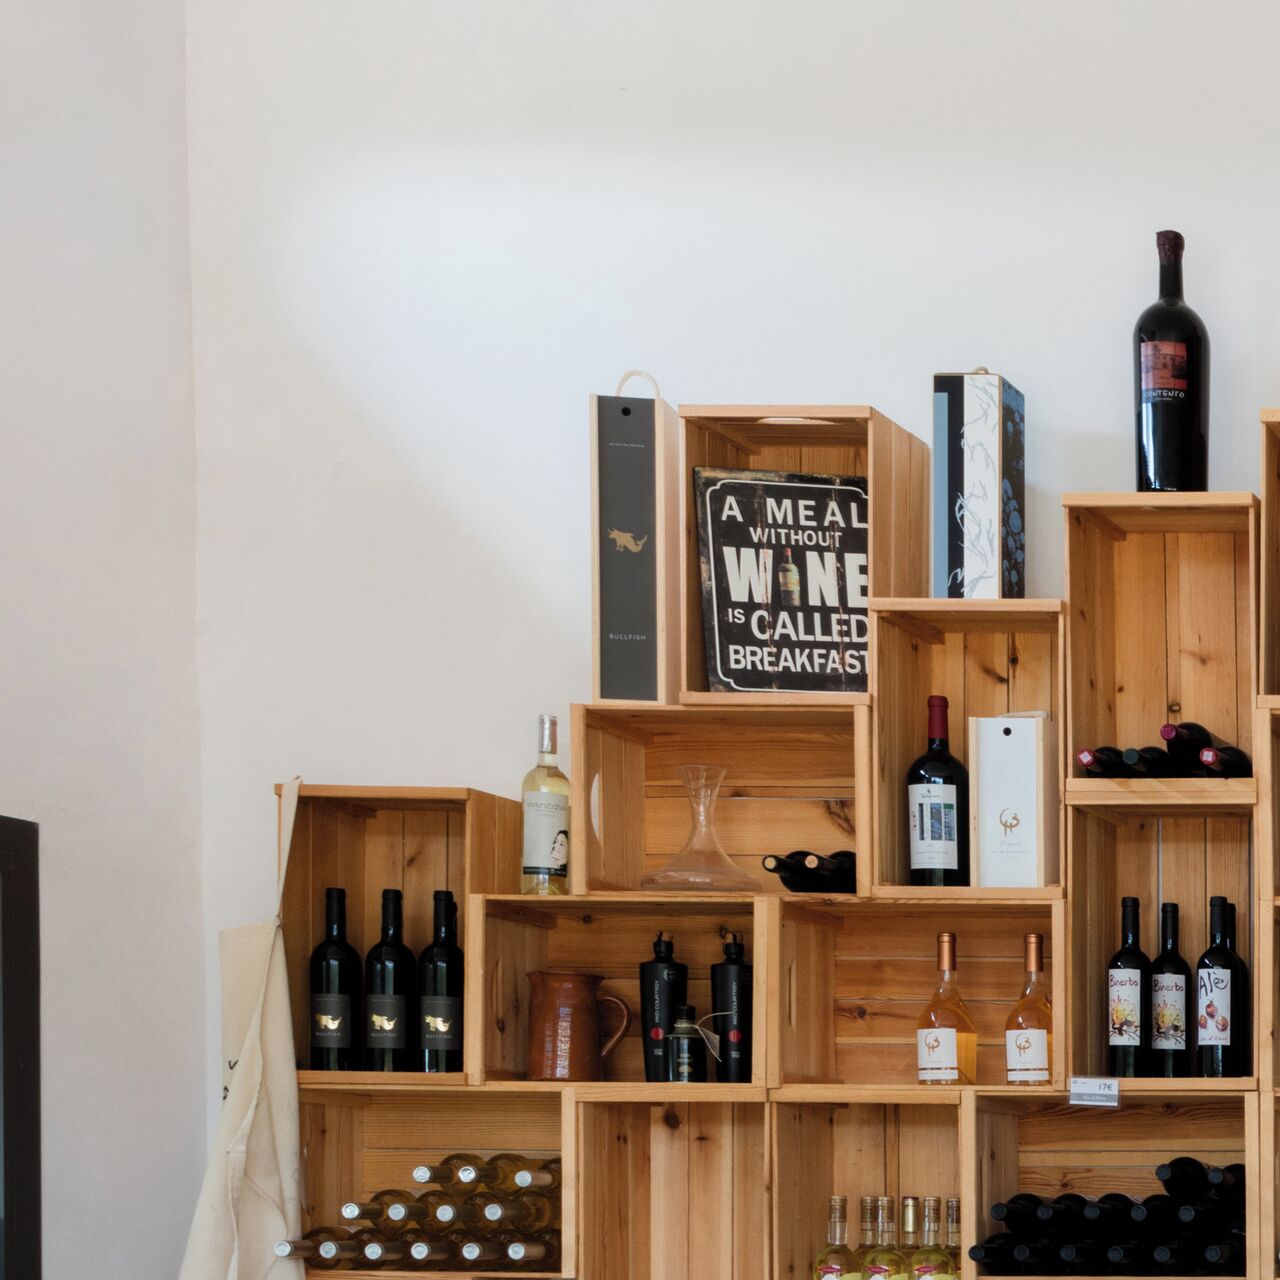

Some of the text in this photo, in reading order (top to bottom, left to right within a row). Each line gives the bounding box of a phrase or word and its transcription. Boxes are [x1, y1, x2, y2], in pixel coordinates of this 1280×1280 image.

[721, 495, 868, 528] A MEAL
[749, 527, 843, 548] WITHOUT
[728, 608, 868, 644] IS CALLED
[608, 633, 647, 641] BULLFISH
[1098, 1083, 1113, 1091] 17€
